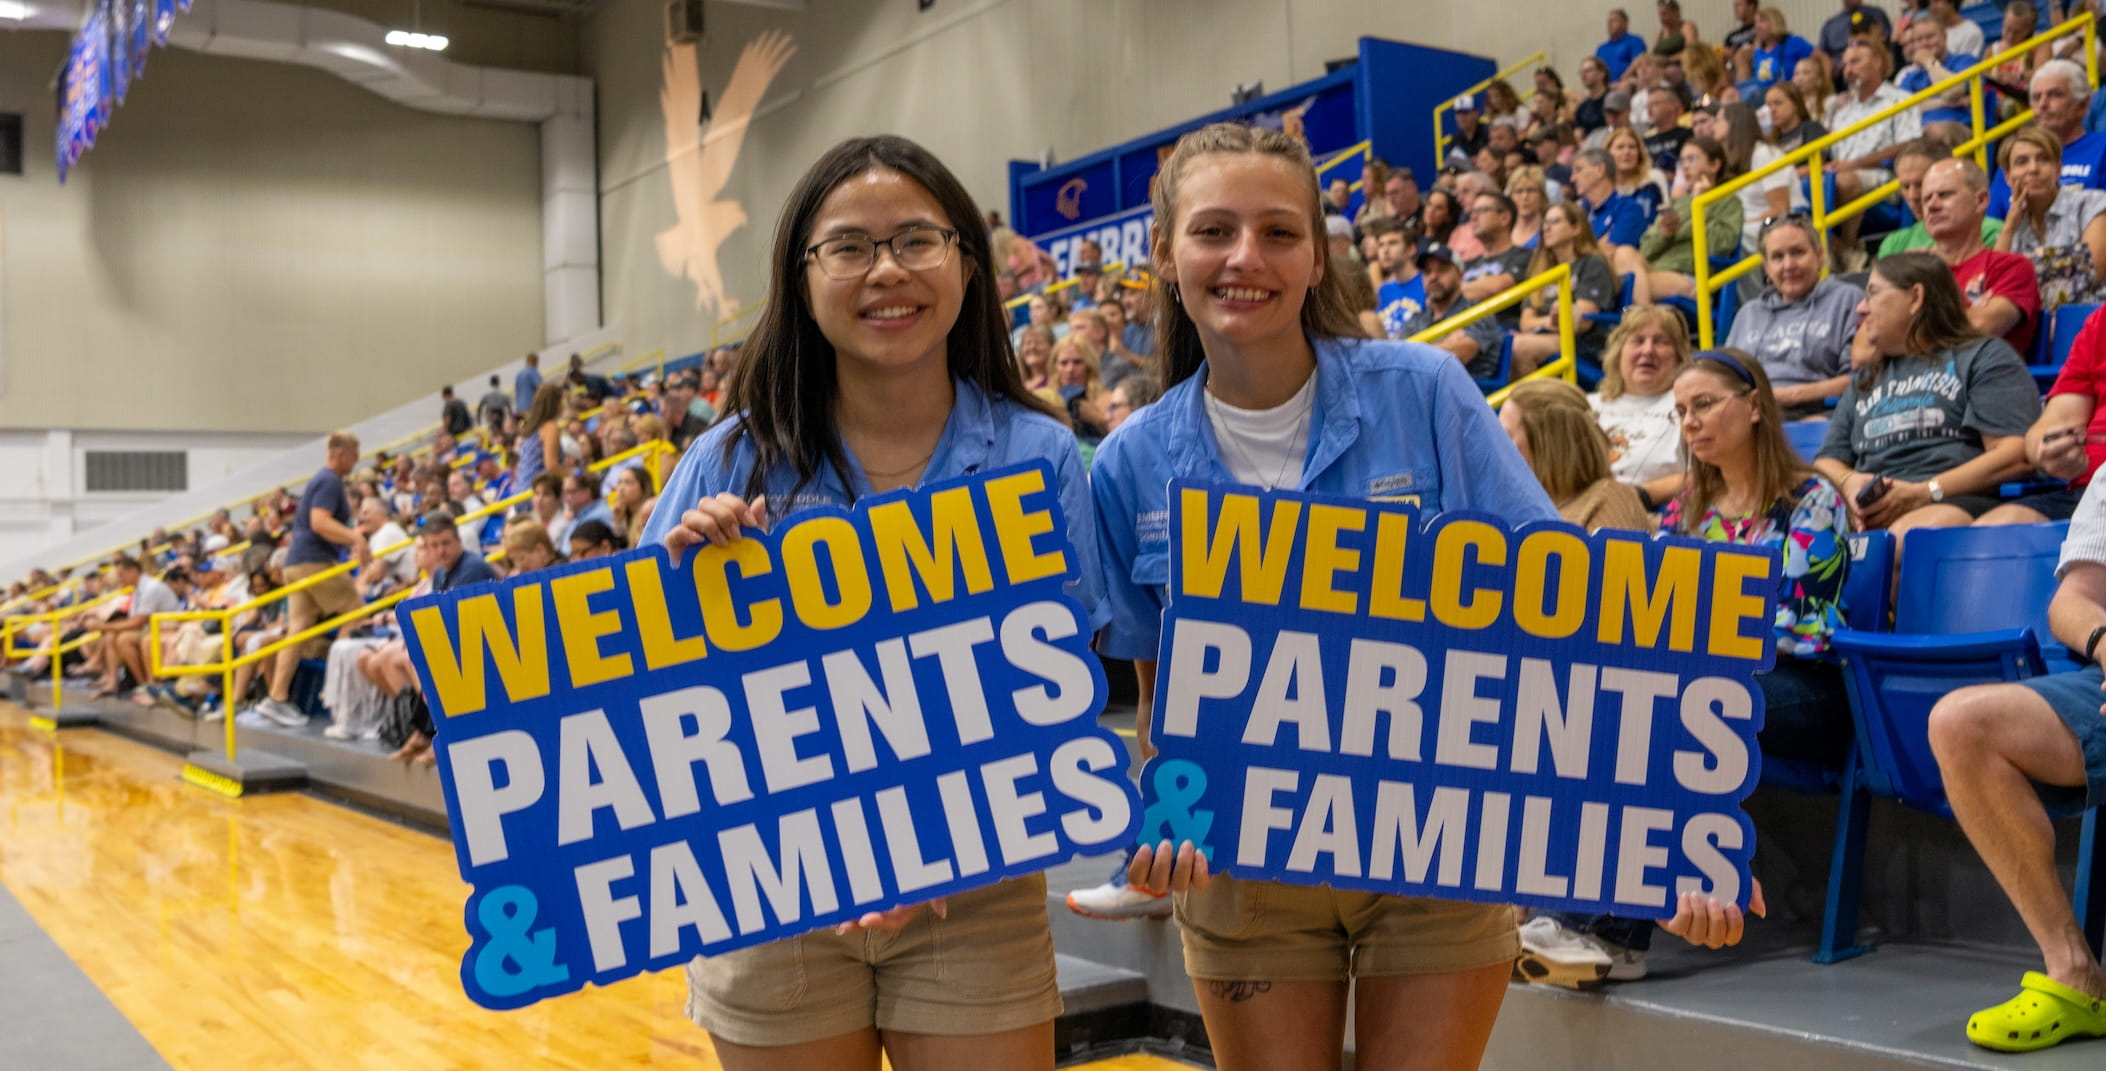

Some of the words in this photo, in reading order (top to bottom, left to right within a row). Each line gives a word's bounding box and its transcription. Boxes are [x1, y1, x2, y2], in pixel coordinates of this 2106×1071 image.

[410, 470, 1067, 717] WELCOME
[1181, 488, 1770, 660] WELCOME
[448, 600, 1095, 867] PARENTS
[1162, 618, 1754, 794] PARENTS
[473, 883, 571, 998] &
[573, 737, 1131, 972] FAMILIES
[1136, 758, 1215, 861] &
[1236, 766, 1744, 907] FAMILIES
